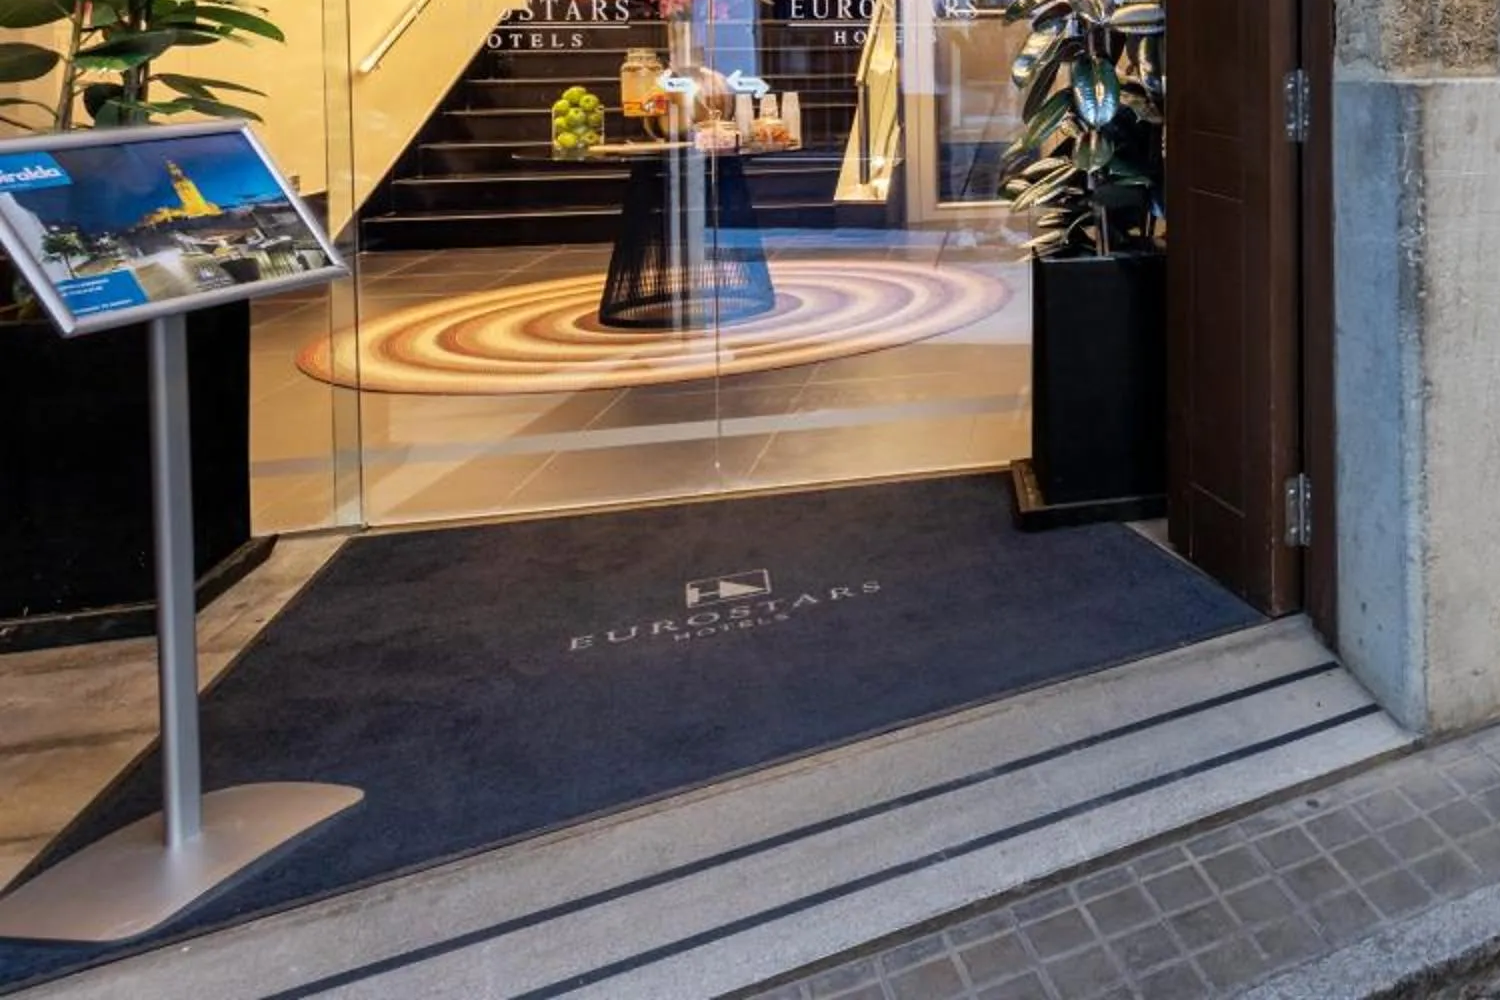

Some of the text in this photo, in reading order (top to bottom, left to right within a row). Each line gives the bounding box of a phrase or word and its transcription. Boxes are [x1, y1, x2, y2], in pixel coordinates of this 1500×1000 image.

[487, 33, 584, 48] OTELS
[570, 580, 881, 651] EUROSTARS
[673, 612, 789, 642] HOTELS
